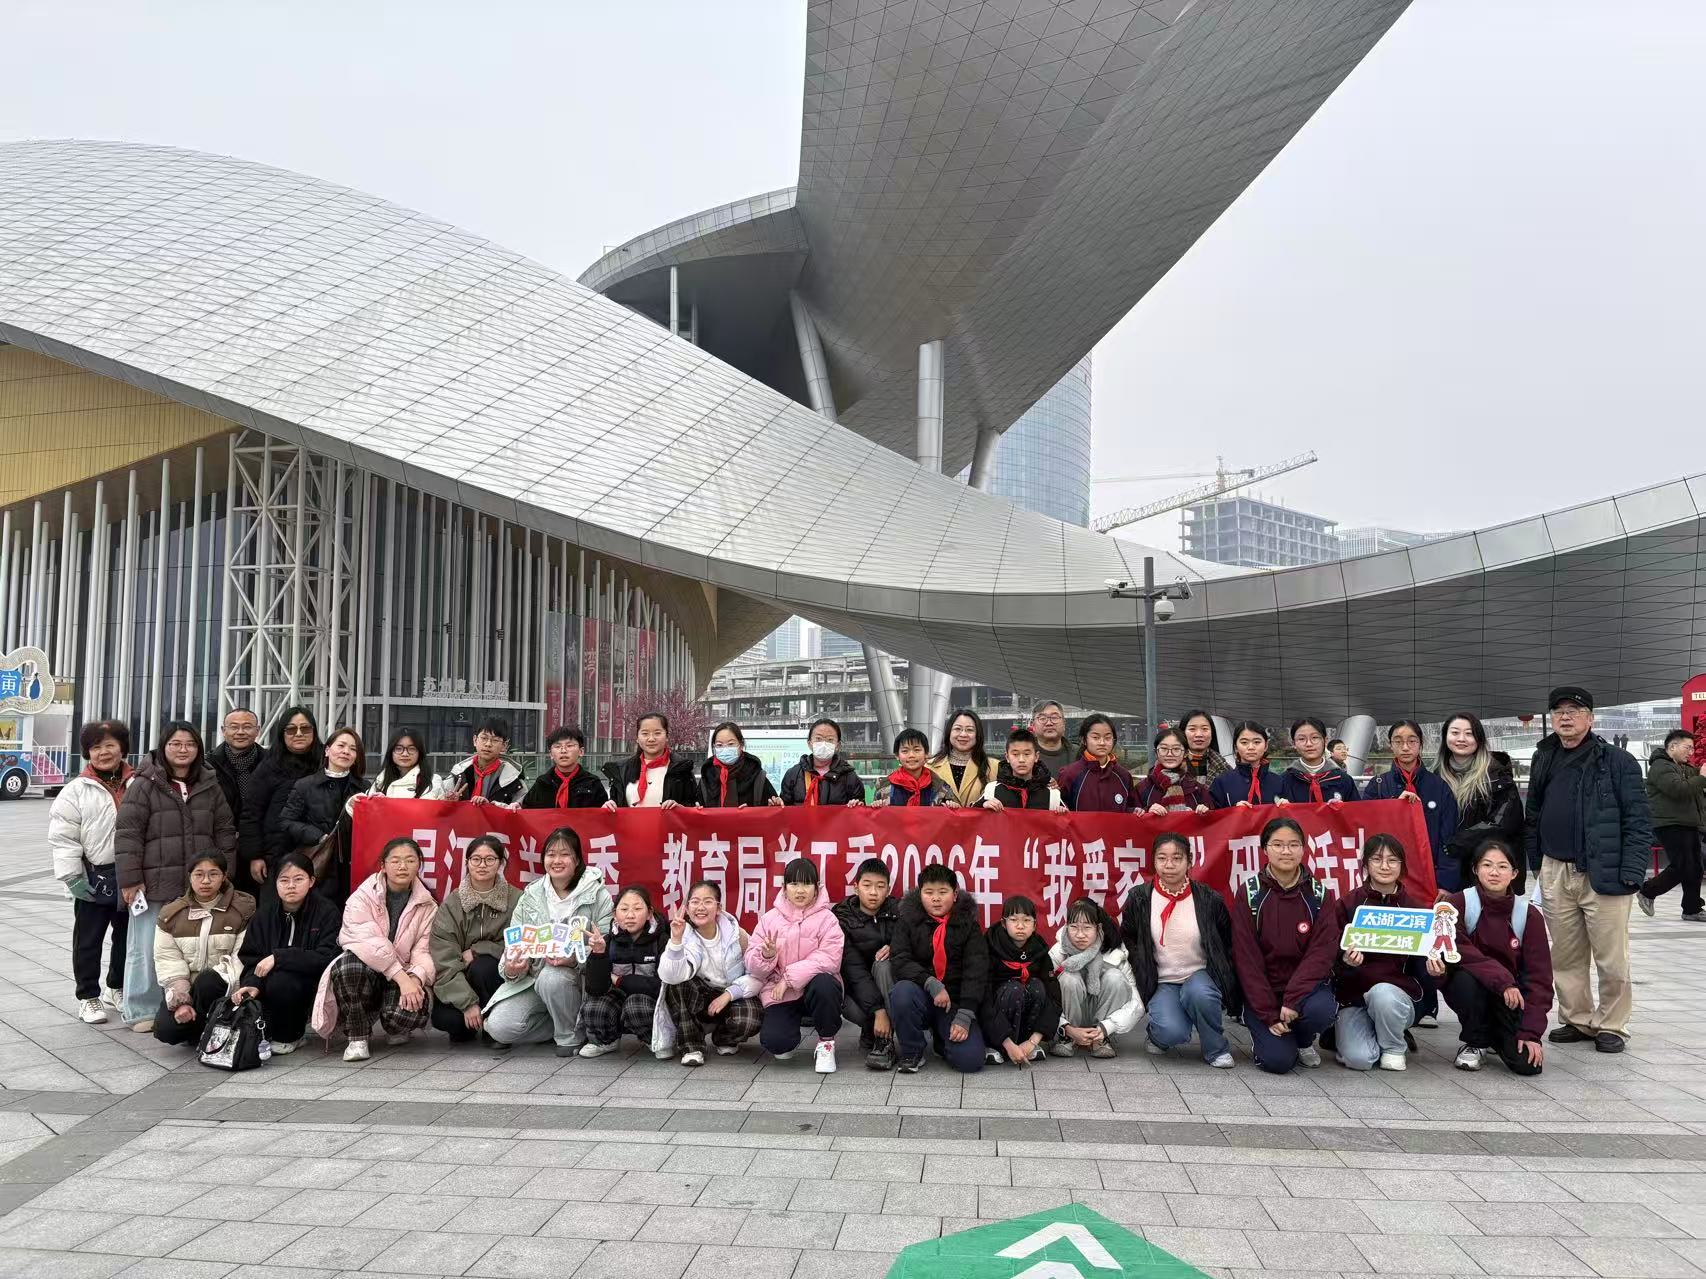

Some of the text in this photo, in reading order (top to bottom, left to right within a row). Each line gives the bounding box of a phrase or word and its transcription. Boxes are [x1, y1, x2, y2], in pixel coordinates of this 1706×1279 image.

[1, 672, 17, 695] 寅
[1361, 912, 1427, 928] 太湖之滨
[1348, 932, 1414, 949] 文化之城
[510, 943, 560, 955] 天天向上
